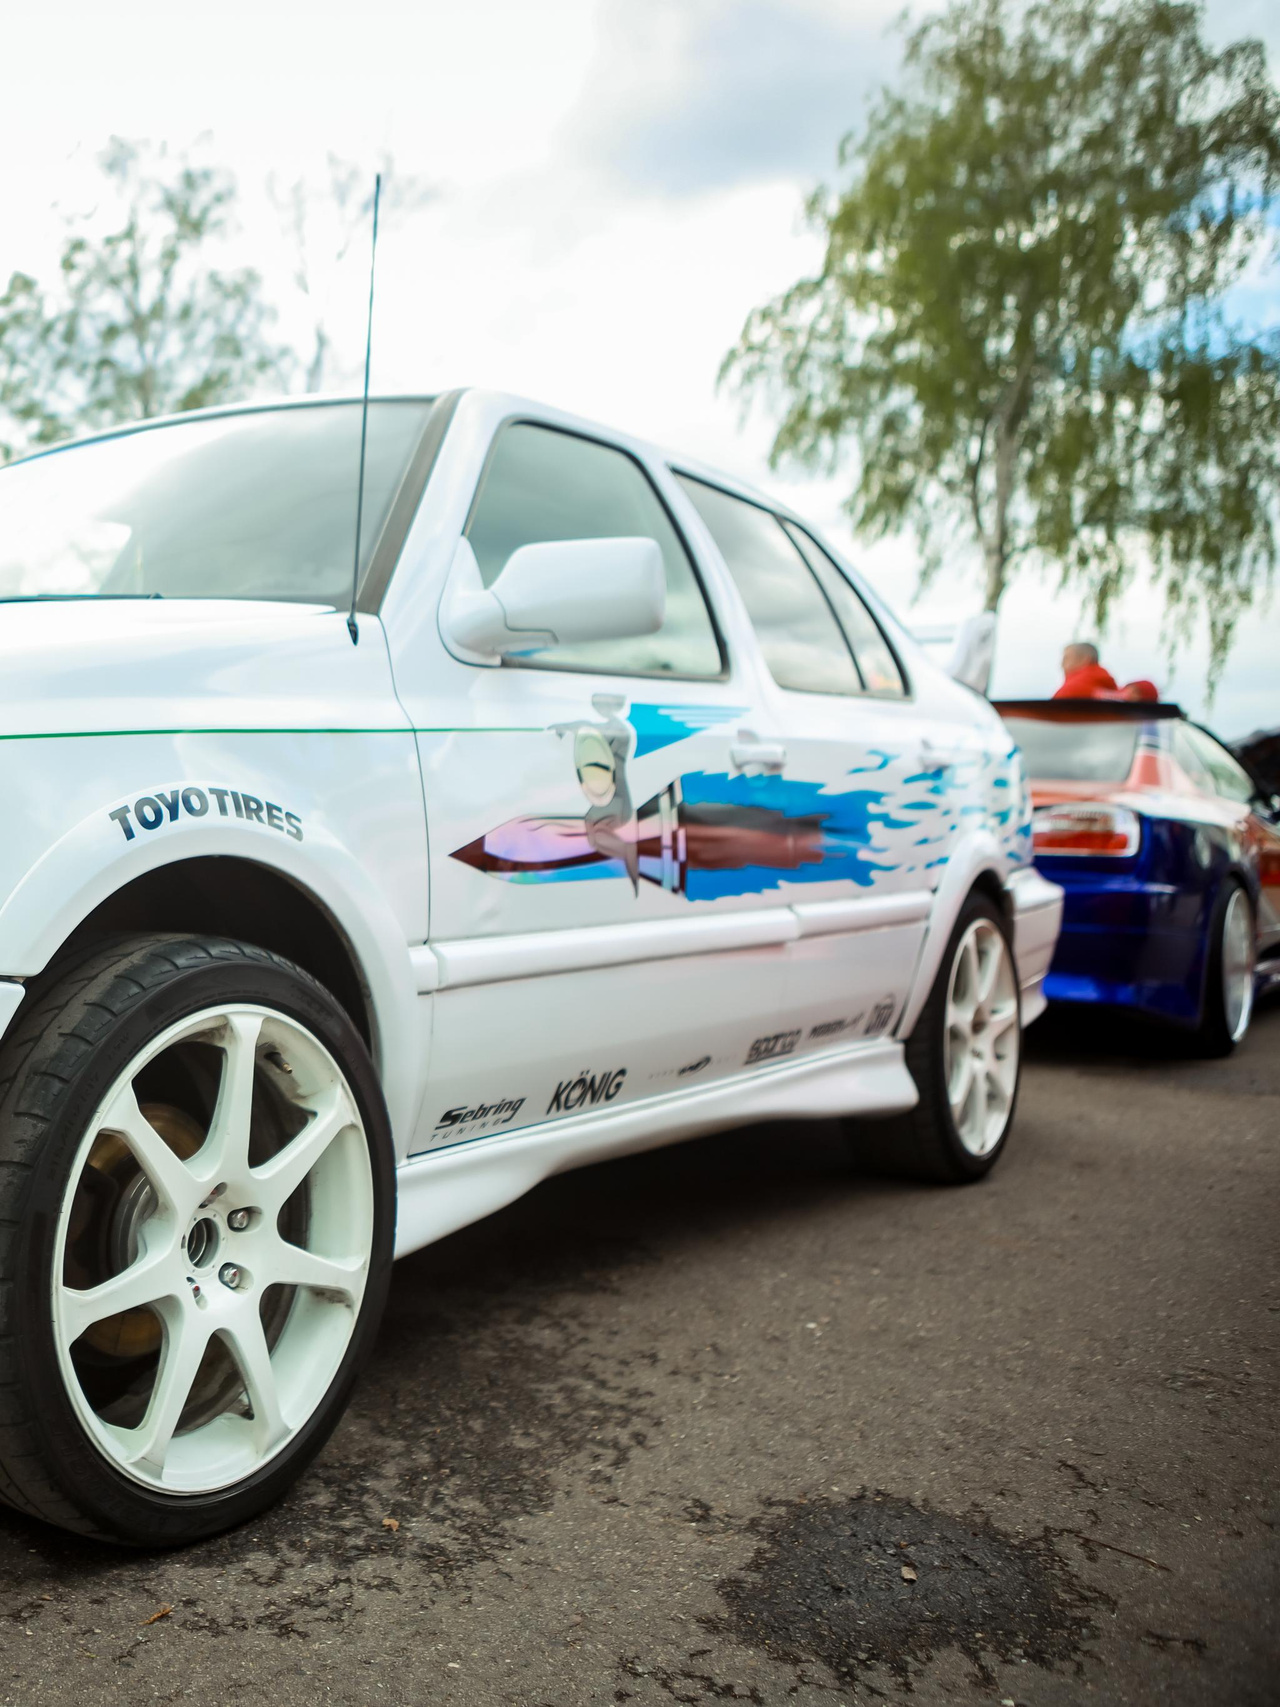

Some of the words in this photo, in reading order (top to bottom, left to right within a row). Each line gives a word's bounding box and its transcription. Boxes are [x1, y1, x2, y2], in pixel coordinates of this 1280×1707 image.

[546, 1067, 628, 1116] KÖNIG
[429, 1118, 502, 1142] TUNING
[434, 1097, 528, 1130] Sebring
